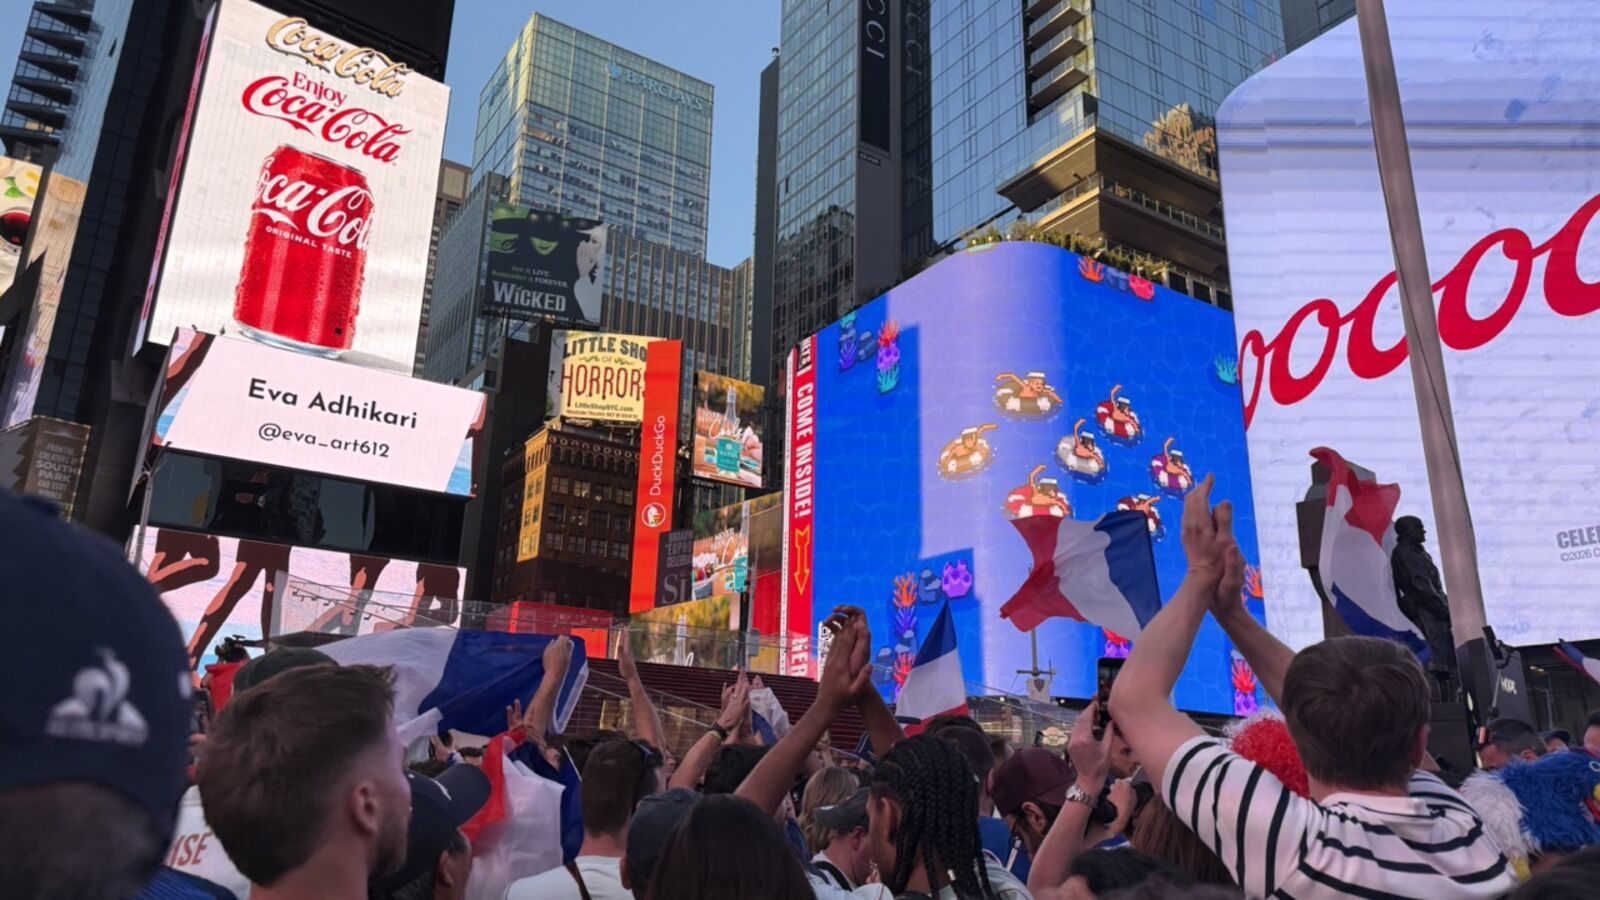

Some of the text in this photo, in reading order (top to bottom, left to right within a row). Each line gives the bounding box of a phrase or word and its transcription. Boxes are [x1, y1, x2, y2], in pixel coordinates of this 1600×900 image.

[292, 71, 347, 107] Enjoy
[626, 68, 702, 111] BARCLAYS
[242, 75, 413, 163] Coca-Cola
[265, 226, 352, 258] ORIGINAL TASTE
[562, 336, 647, 363] LITTLE SHO
[248, 377, 418, 429] Eva Adhikari
[258, 422, 390, 458] @eva_art612
[650, 415, 666, 496] DuckDuckGo
[794, 382, 814, 519] COME INSIDE!
[35, 459, 77, 475] SOUTH
[38, 468, 71, 483] PARK
